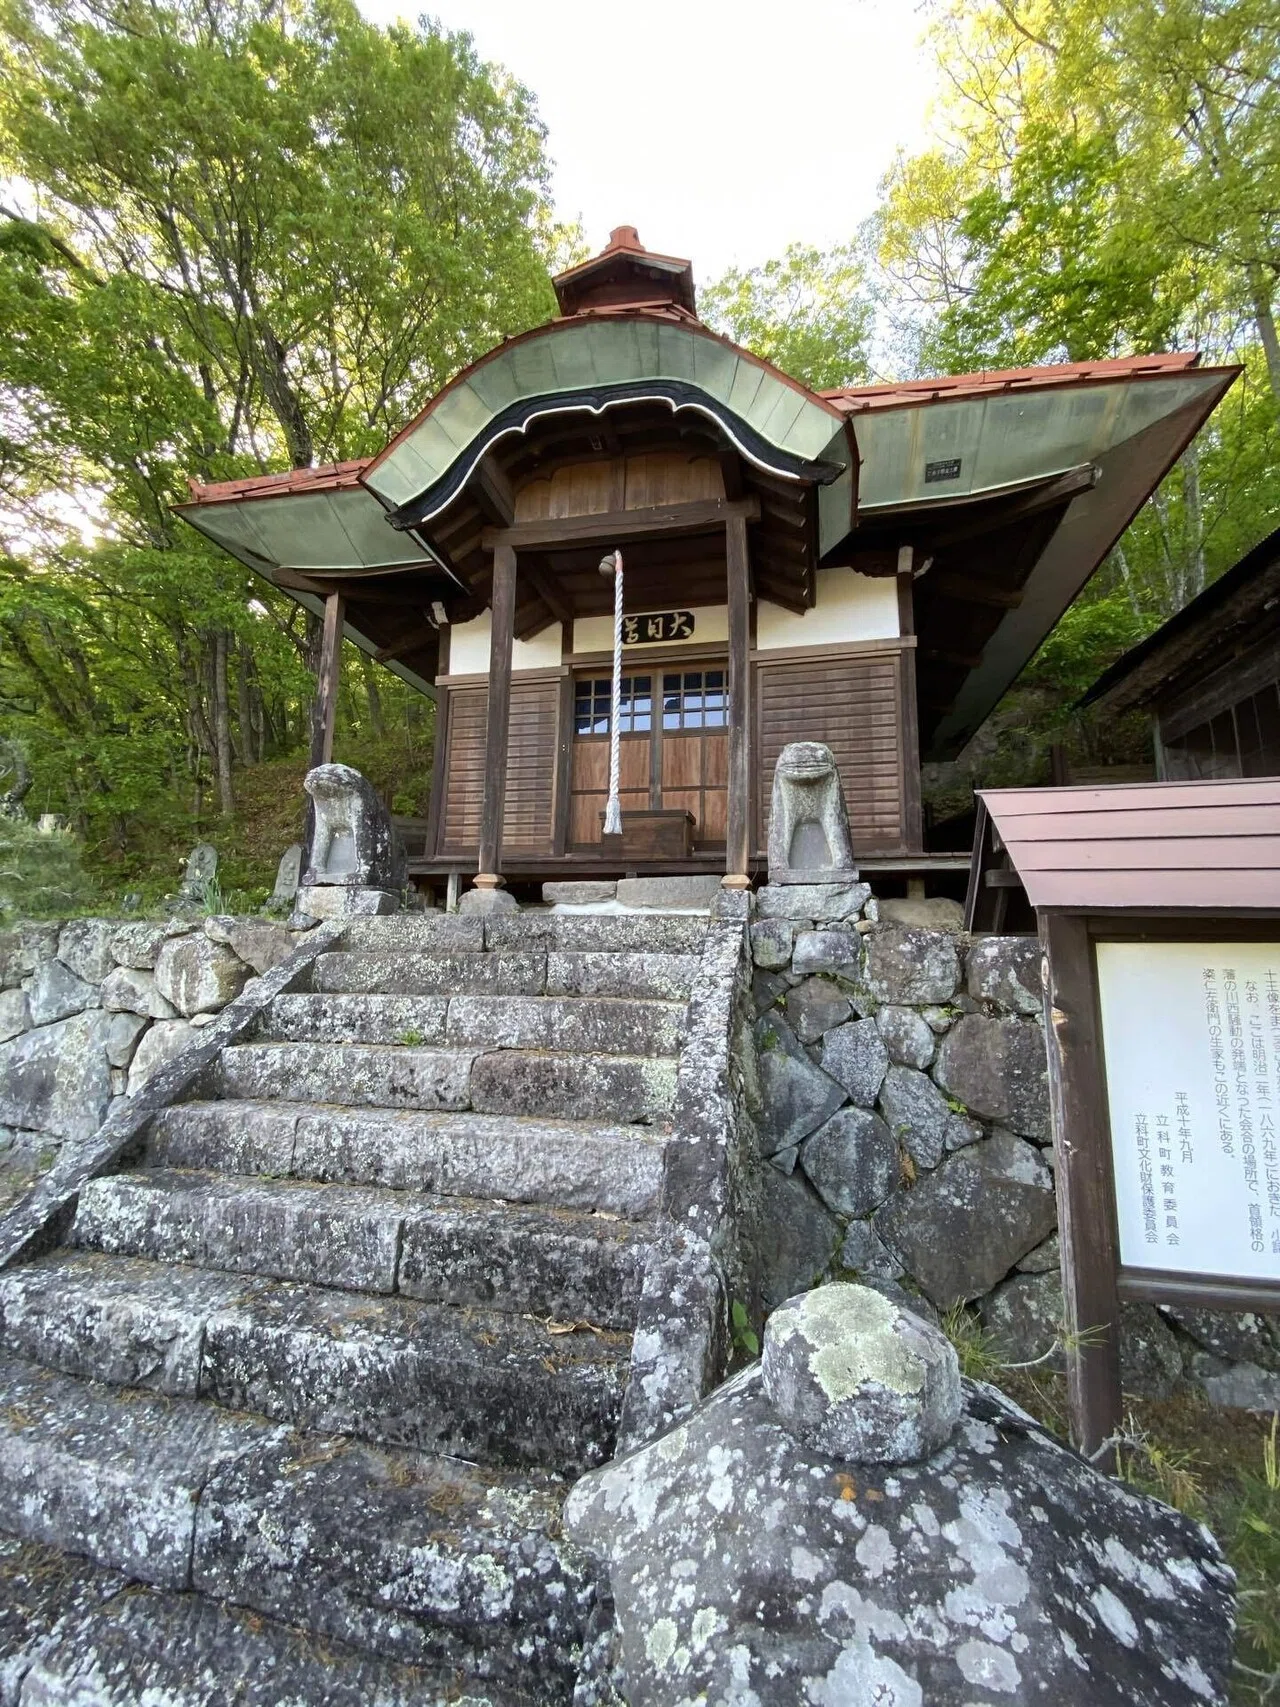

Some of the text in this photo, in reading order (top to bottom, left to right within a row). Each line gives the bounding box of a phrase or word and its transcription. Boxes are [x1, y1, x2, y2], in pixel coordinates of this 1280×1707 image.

[1174, 1091, 1193, 1164] 平成十年九月
